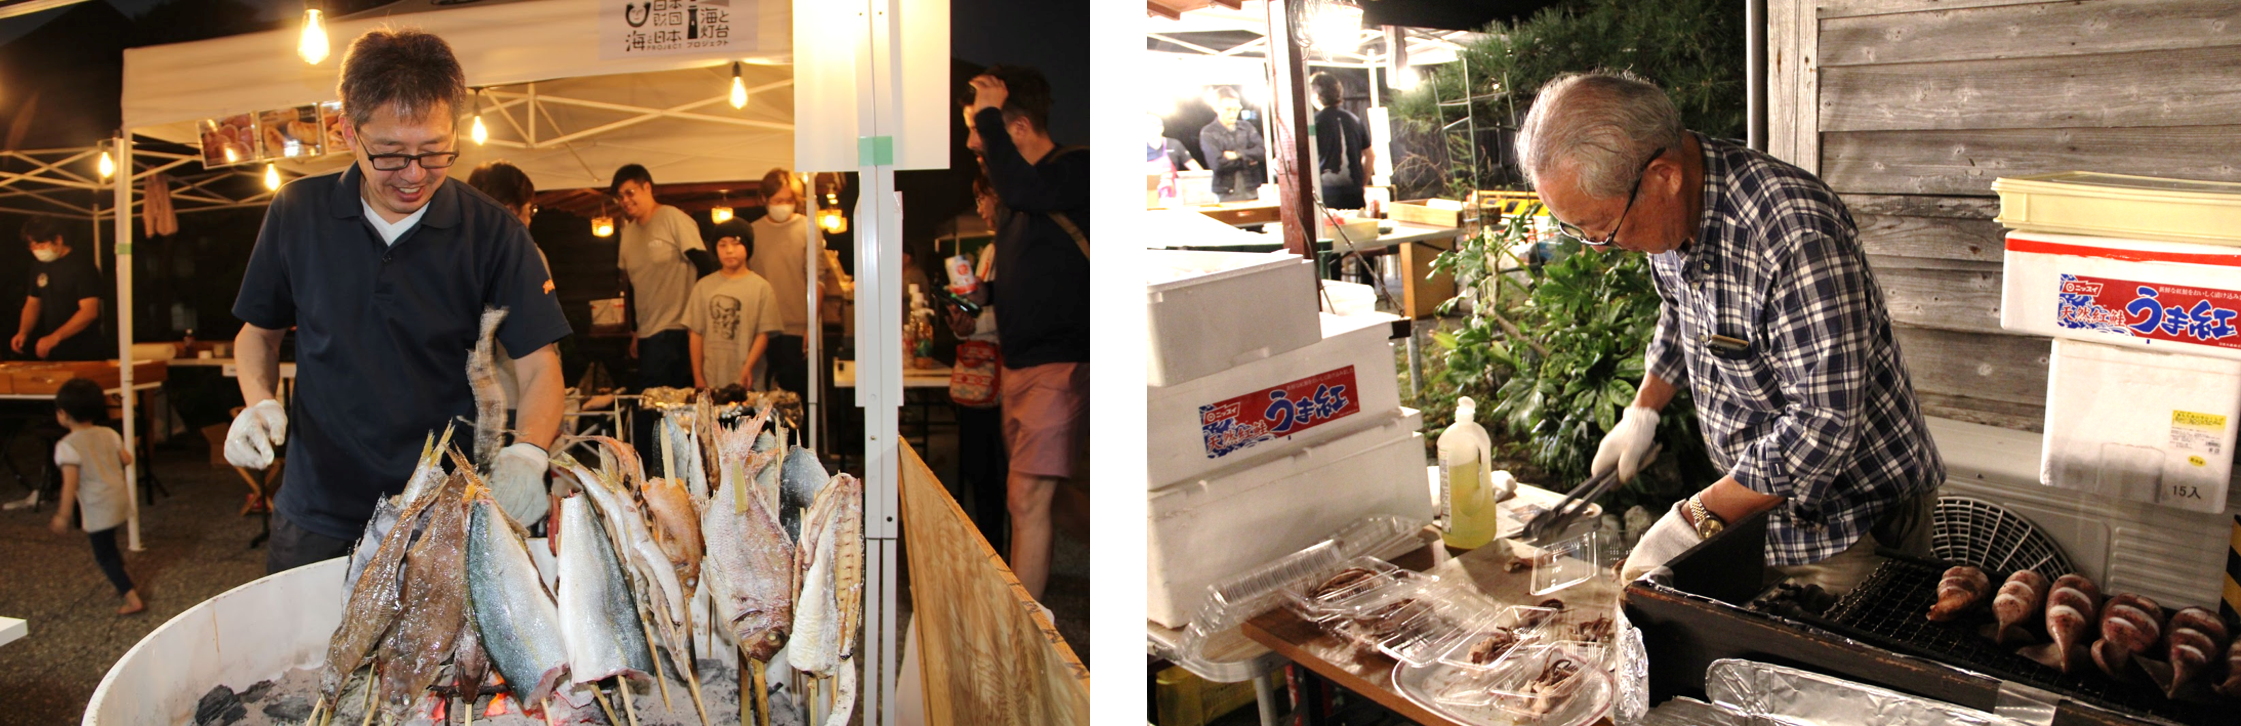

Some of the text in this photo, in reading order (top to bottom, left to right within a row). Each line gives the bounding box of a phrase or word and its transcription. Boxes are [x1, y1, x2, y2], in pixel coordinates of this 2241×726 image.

[700, 24, 730, 39] 灯台
[687, 40, 729, 48] プロジェクト
[2075, 284, 2099, 295] ニッスイ
[2059, 304, 2127, 328] 天然紅鮭
[2124, 285, 2238, 341] うま紅
[1215, 406, 1238, 419] ニッスイ
[1264, 383, 1349, 433] うま紅
[1207, 419, 1269, 455] 天然紅鮭
[2172, 484, 2202, 500] 15入
